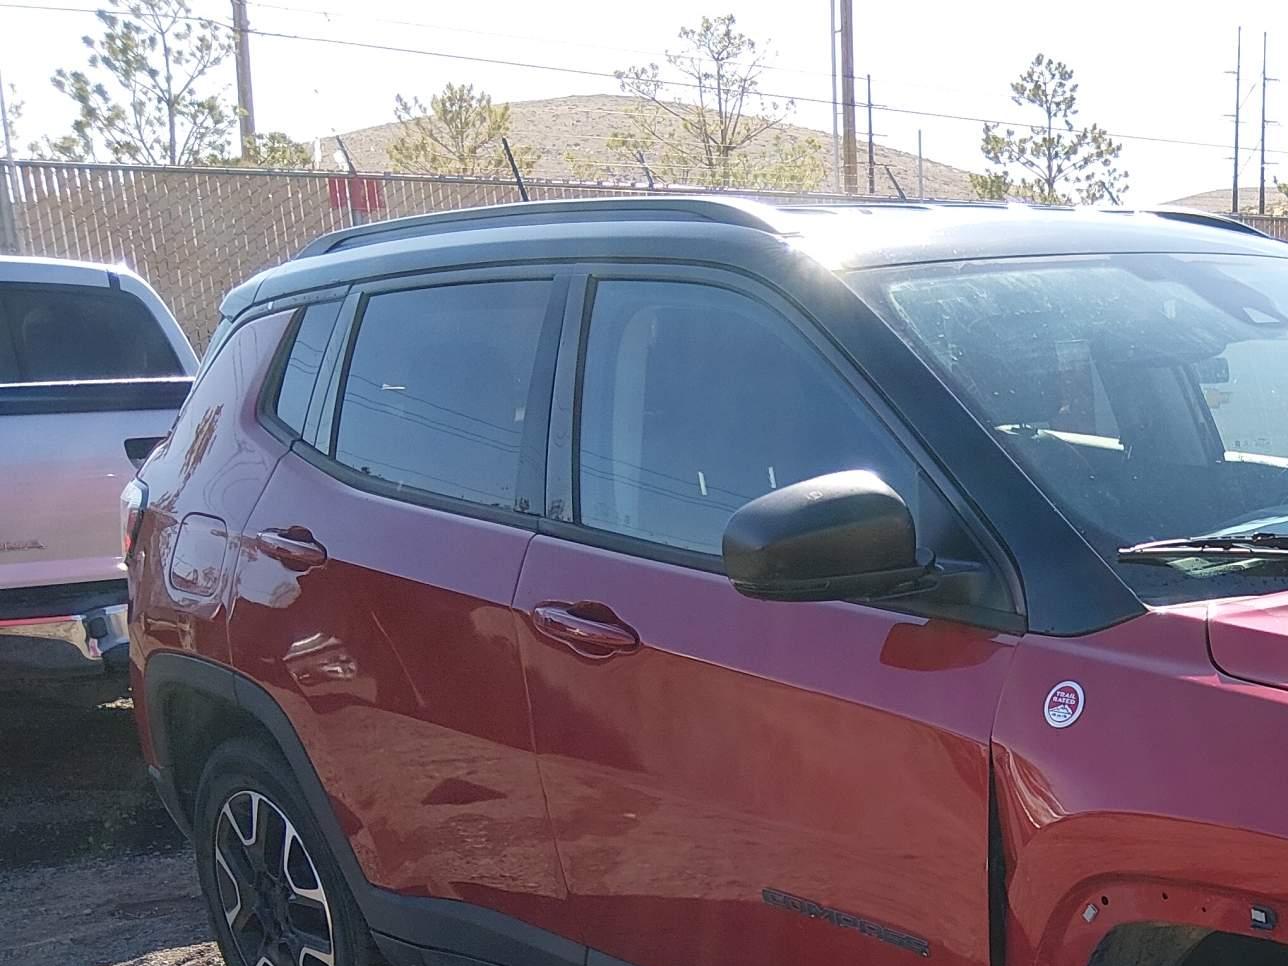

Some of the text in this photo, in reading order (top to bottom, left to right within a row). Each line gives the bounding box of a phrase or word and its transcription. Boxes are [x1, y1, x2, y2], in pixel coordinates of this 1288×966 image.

[1056, 691, 1077, 700] TRAIL
[1052, 697, 1076, 705] RATED
[762, 887, 929, 957] COMPASS
